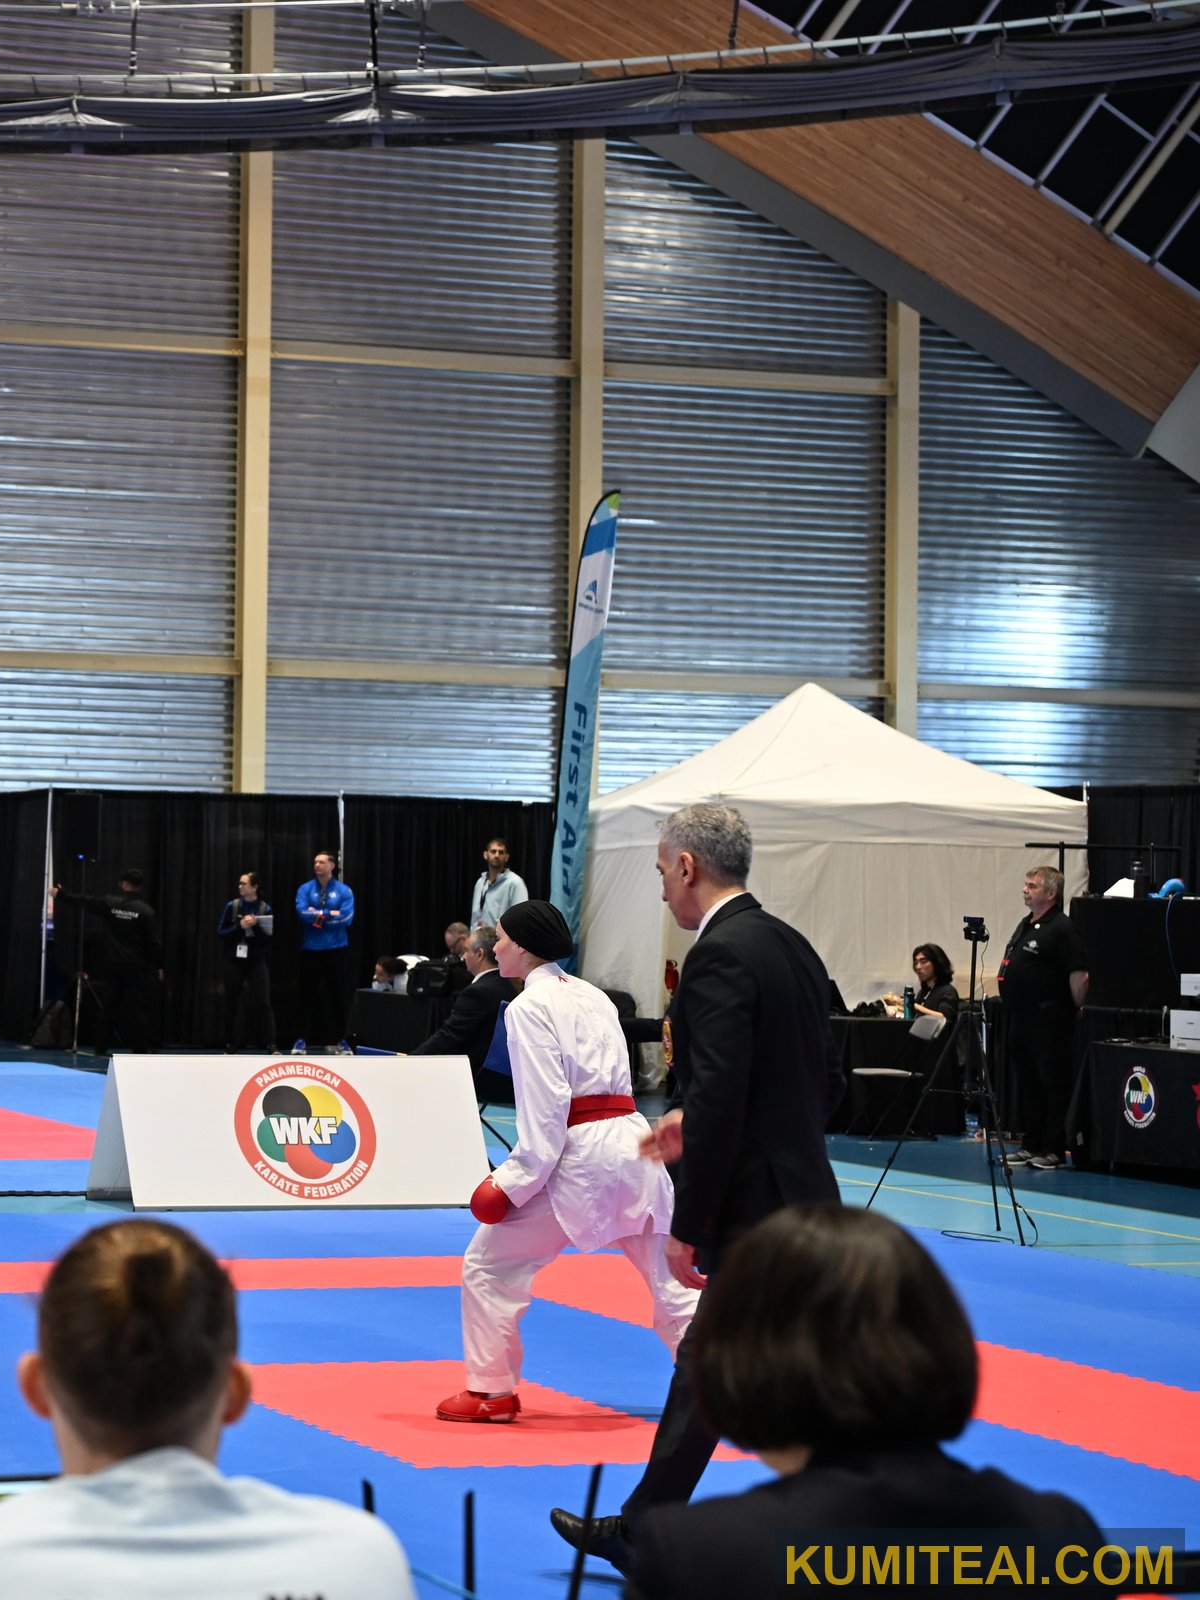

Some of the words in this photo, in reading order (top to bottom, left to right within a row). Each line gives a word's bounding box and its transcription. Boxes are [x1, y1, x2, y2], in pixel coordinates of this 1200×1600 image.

[565, 702, 587, 808] First
[255, 1064, 341, 1088] PANAMERICAN
[1130, 1091, 1147, 1103] WKF
[268, 1117, 338, 1145] WKF
[254, 1160, 300, 1196] KARATE
[303, 1159, 369, 1198] FEDERATION
